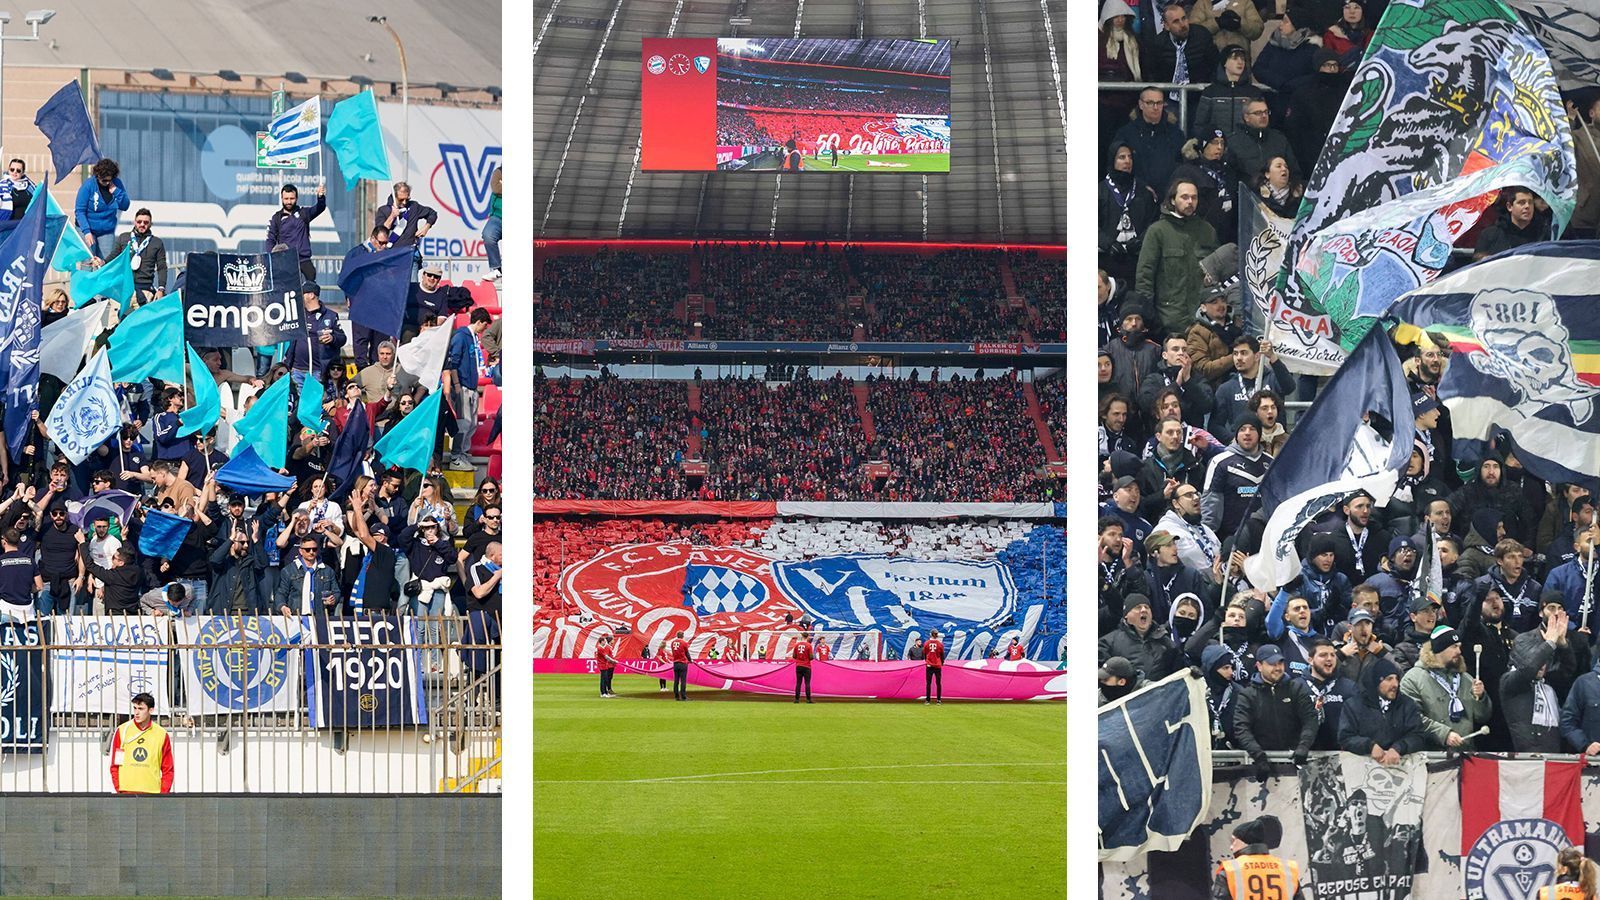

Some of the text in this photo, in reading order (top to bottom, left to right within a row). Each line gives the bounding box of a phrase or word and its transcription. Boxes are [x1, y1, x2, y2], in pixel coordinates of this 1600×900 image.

[187, 291, 298, 335] empoli
[279, 321, 300, 332] ultras
[688, 342, 709, 350] Allianz
[828, 343, 849, 351] Allianz
[3, 626, 39, 646] AS
[328, 620, 395, 654] EFC
[325, 656, 403, 691] 1920
[1244, 862, 1279, 870] STADIER
[1247, 873, 1282, 900] 95
[1317, 877, 1369, 896] REPOSE
[1373, 875, 1387, 889] EN
[1389, 875, 1412, 889] PAI
[1557, 885, 1582, 893] STAD
